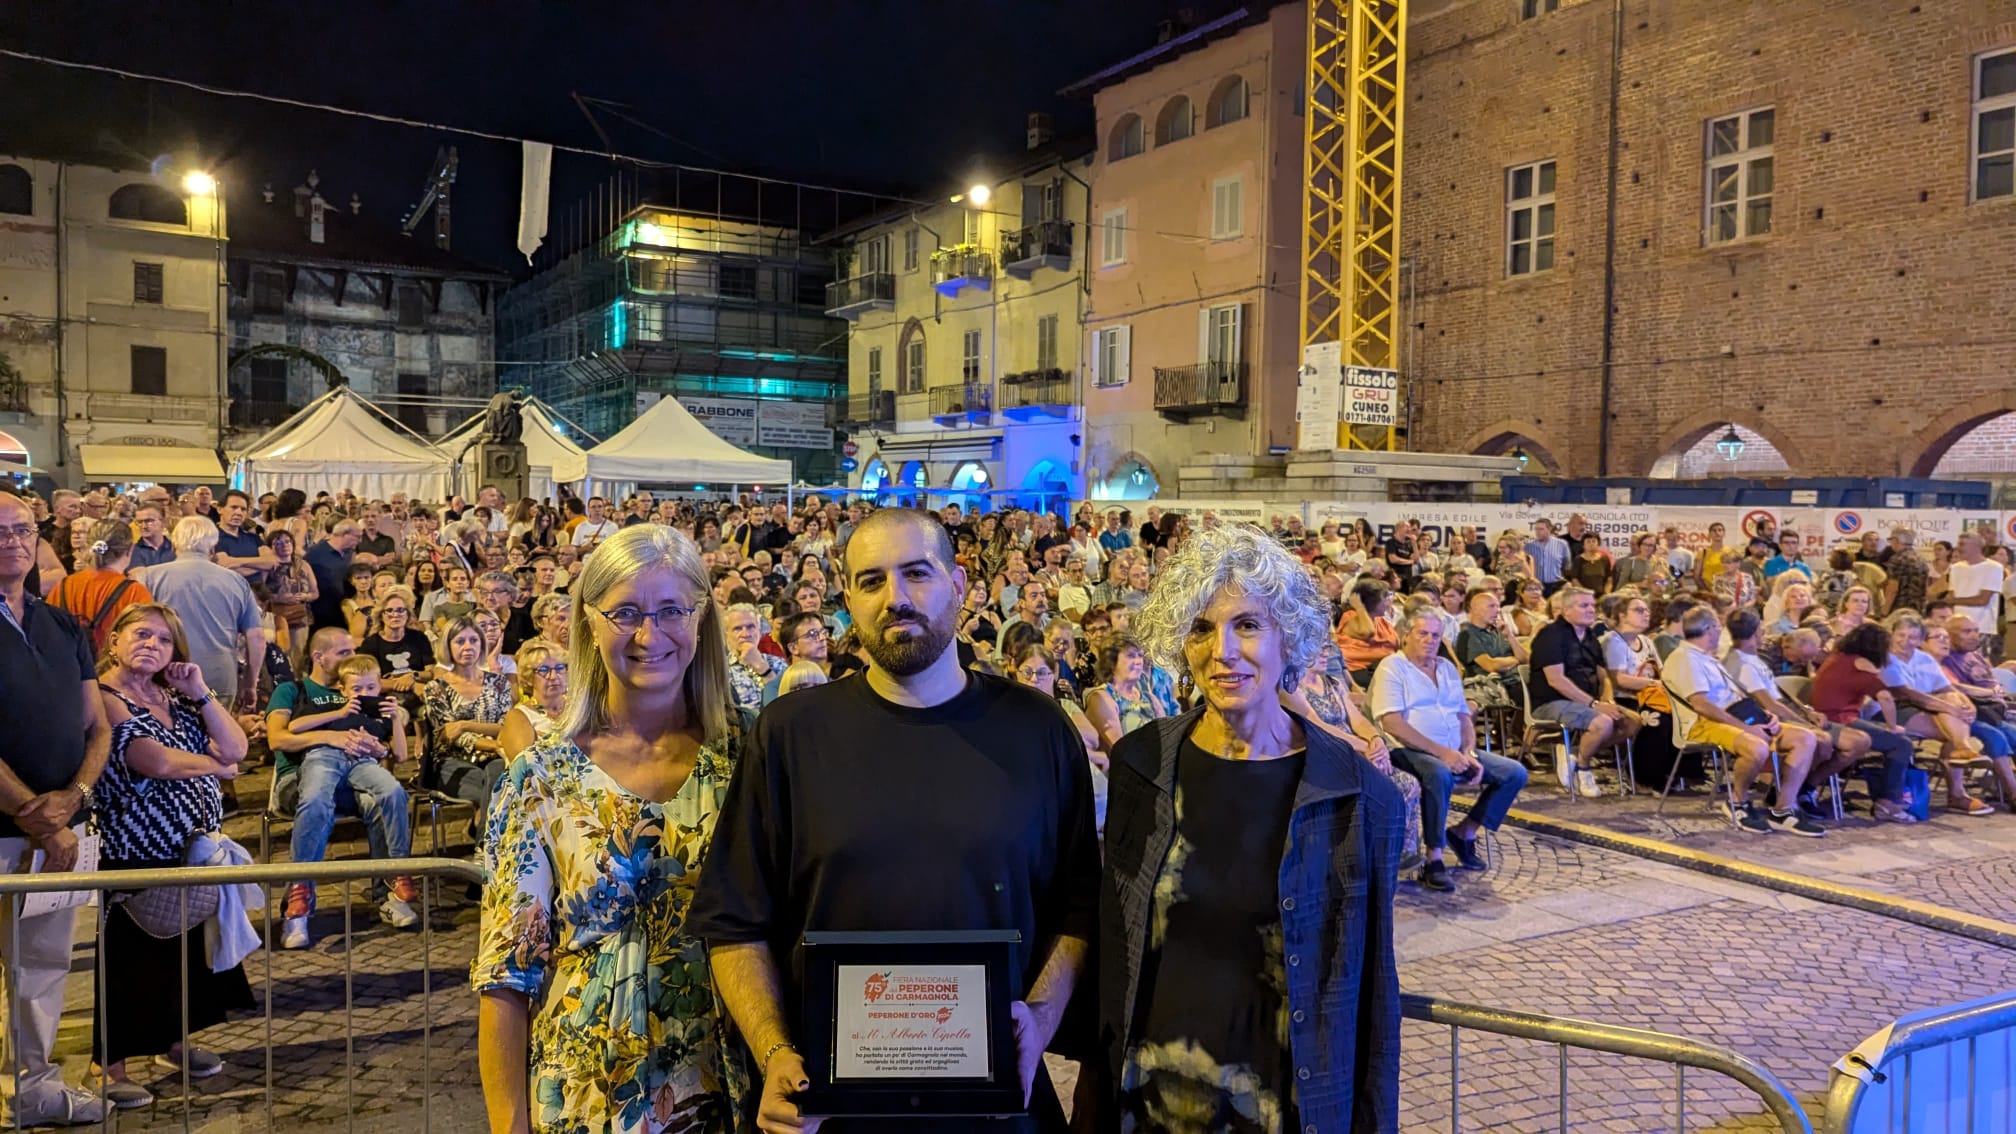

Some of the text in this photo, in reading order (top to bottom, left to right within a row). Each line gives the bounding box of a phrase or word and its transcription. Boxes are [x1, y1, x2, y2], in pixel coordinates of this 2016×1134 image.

[1347, 368, 1396, 388] fissolo
[1352, 388, 1389, 401] GRU
[688, 405, 755, 417] RABBONE
[1352, 402, 1388, 413] CUNEO
[1346, 413, 1395, 424] 0171-687061
[1397, 512, 1488, 523] IMPRESA EDILE
[1557, 511, 1626, 521] CAAGNOLA
[868, 983, 882, 992] 75
[899, 984, 959, 992] PEPERONE
[896, 993, 959, 1001] CARMAGNOLA
